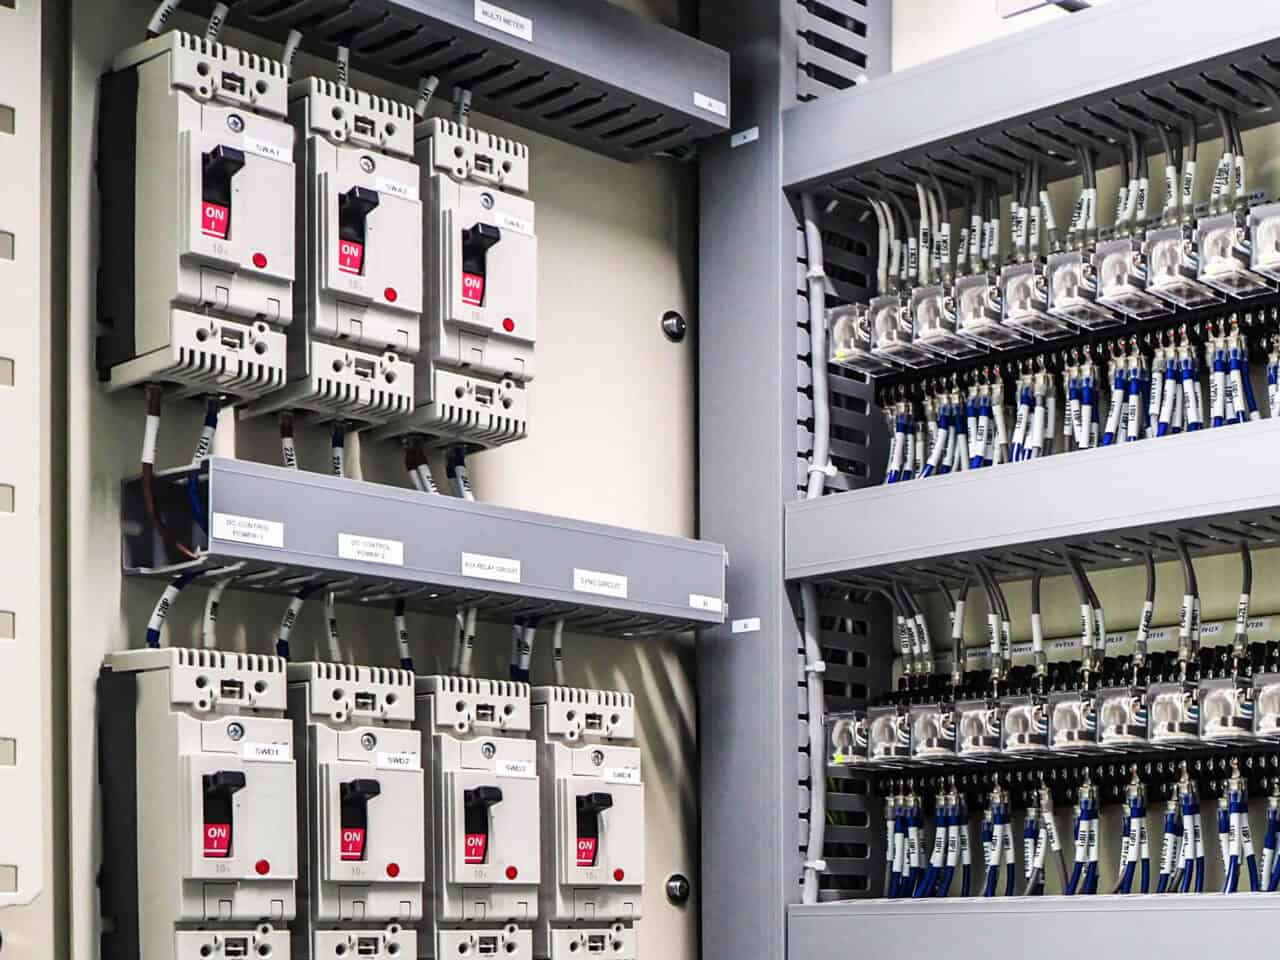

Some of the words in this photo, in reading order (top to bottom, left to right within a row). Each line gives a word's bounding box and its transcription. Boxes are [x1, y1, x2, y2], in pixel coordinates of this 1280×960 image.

[481, 9, 503, 23] MULTI
[503, 15, 525, 31] METER
[205, 206, 225, 221] ON
[341, 244, 359, 258] ON
[464, 276, 480, 290] ON
[208, 827, 226, 839] ON
[343, 831, 361, 842] ON
[467, 836, 484, 847] ON
[578, 841, 593, 851] ON
